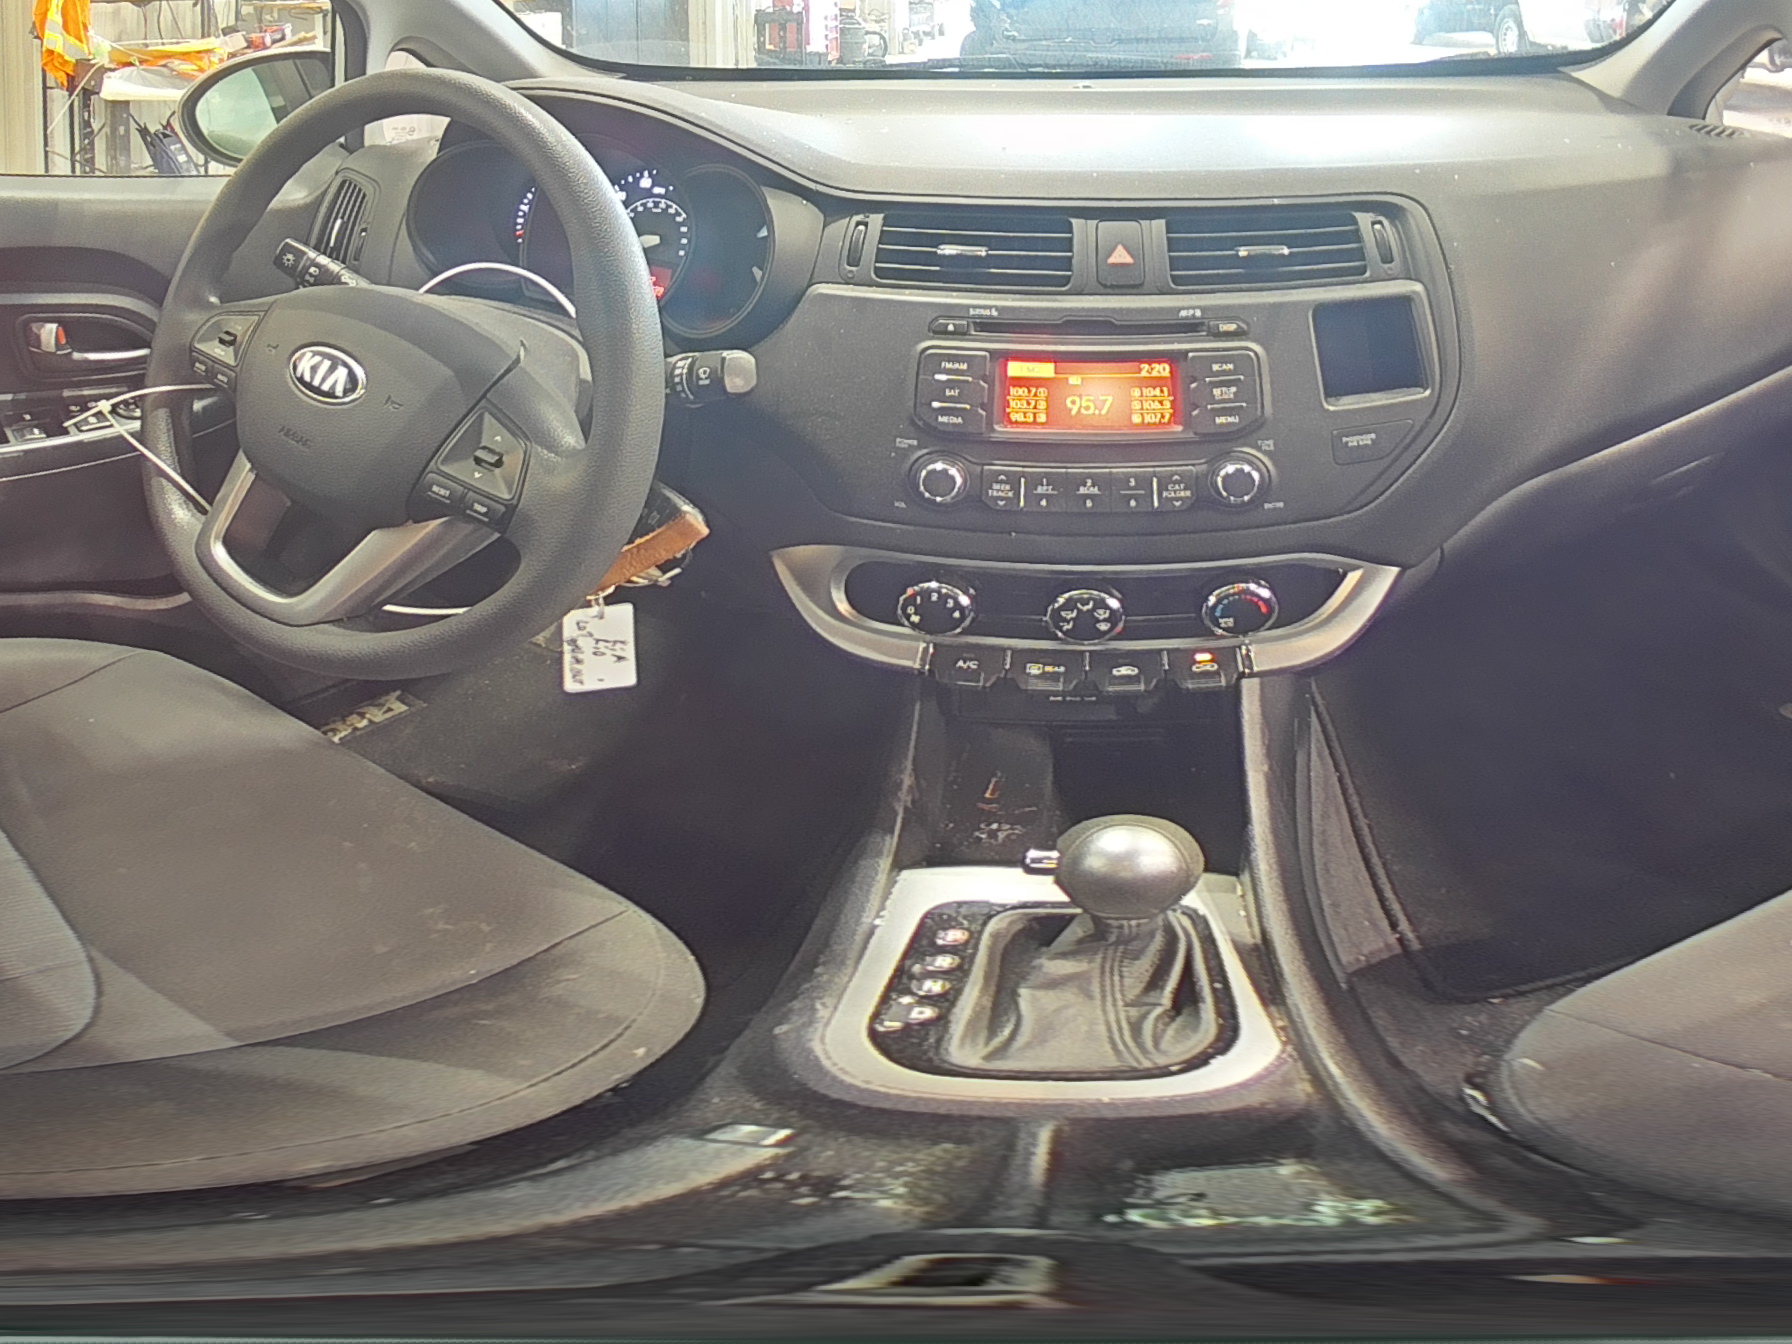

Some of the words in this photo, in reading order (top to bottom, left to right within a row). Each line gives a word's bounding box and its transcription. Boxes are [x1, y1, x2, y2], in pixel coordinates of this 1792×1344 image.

[295, 352, 351, 398] KIA
[1065, 395, 1114, 416] 95.7
[938, 415, 963, 425] MEDIA
[1215, 416, 1239, 425] MENU
[931, 592, 938, 601] 2
[952, 610, 960, 618] 4
[956, 659, 979, 669] A/C
